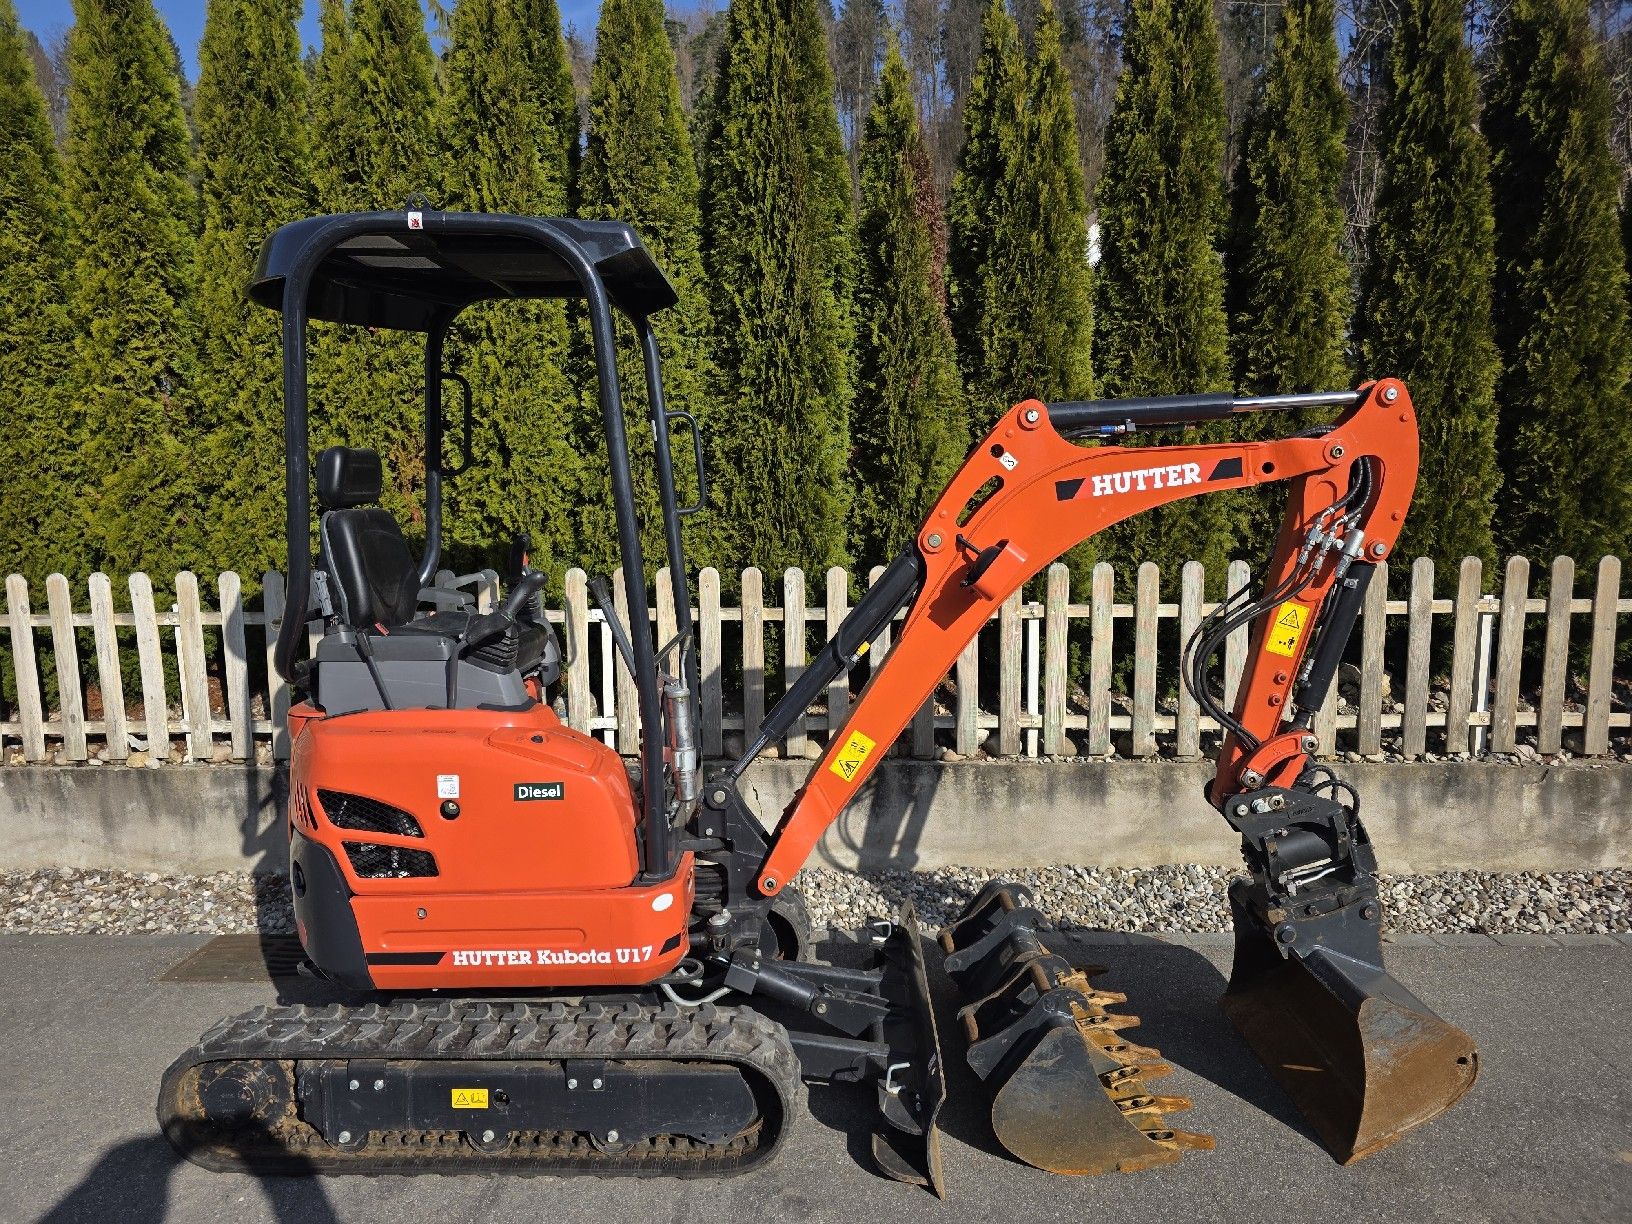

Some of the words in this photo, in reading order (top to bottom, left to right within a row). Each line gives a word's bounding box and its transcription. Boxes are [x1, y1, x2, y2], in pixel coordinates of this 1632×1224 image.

[1091, 462, 1202, 496] HUTTER
[518, 784, 561, 798] Diesel
[452, 950, 533, 965] HUTTER
[536, 949, 612, 964] Kubota
[615, 946, 653, 963] U17
